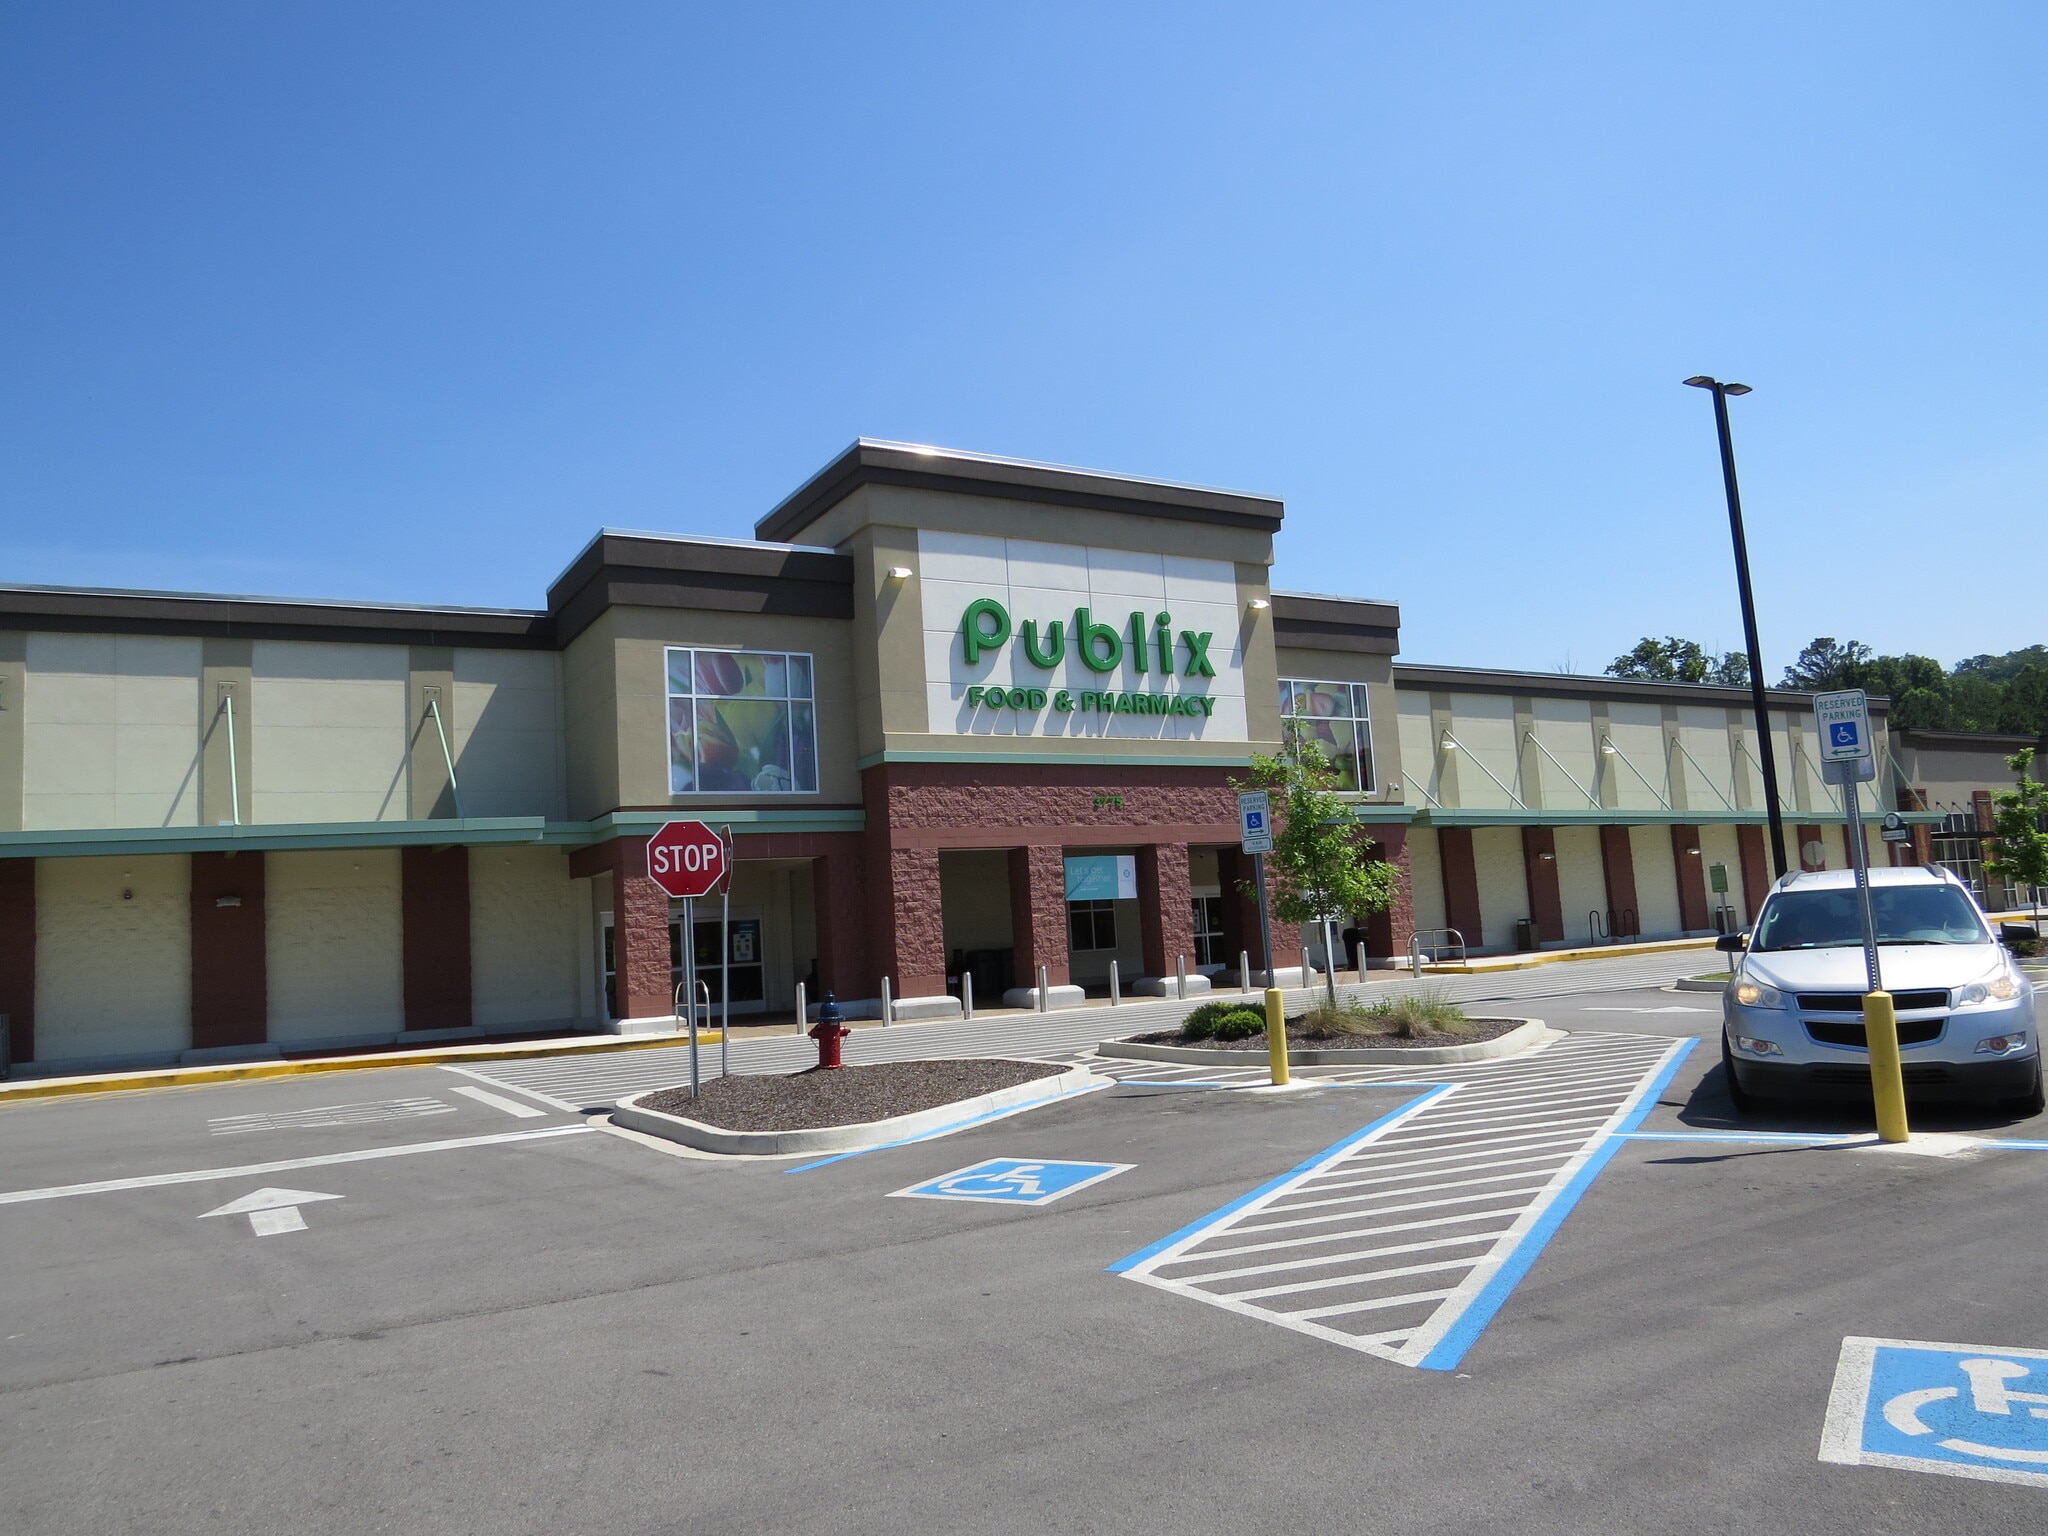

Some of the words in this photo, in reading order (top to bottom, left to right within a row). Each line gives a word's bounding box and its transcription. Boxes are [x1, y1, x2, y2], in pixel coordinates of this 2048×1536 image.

[962, 598, 1216, 677] Publix
[969, 686, 1048, 710] FOOD
[1055, 689, 1075, 712] &
[1081, 692, 1216, 717] PHARMACY
[1818, 698, 1862, 710] RESERVED
[1823, 710, 1861, 721] PARKING
[1094, 795, 1124, 807] 3775
[1240, 795, 1266, 805] RESERVED
[1242, 803, 1265, 812] PARKING
[654, 845, 717, 873] STOP
[1090, 866, 1104, 876] get
